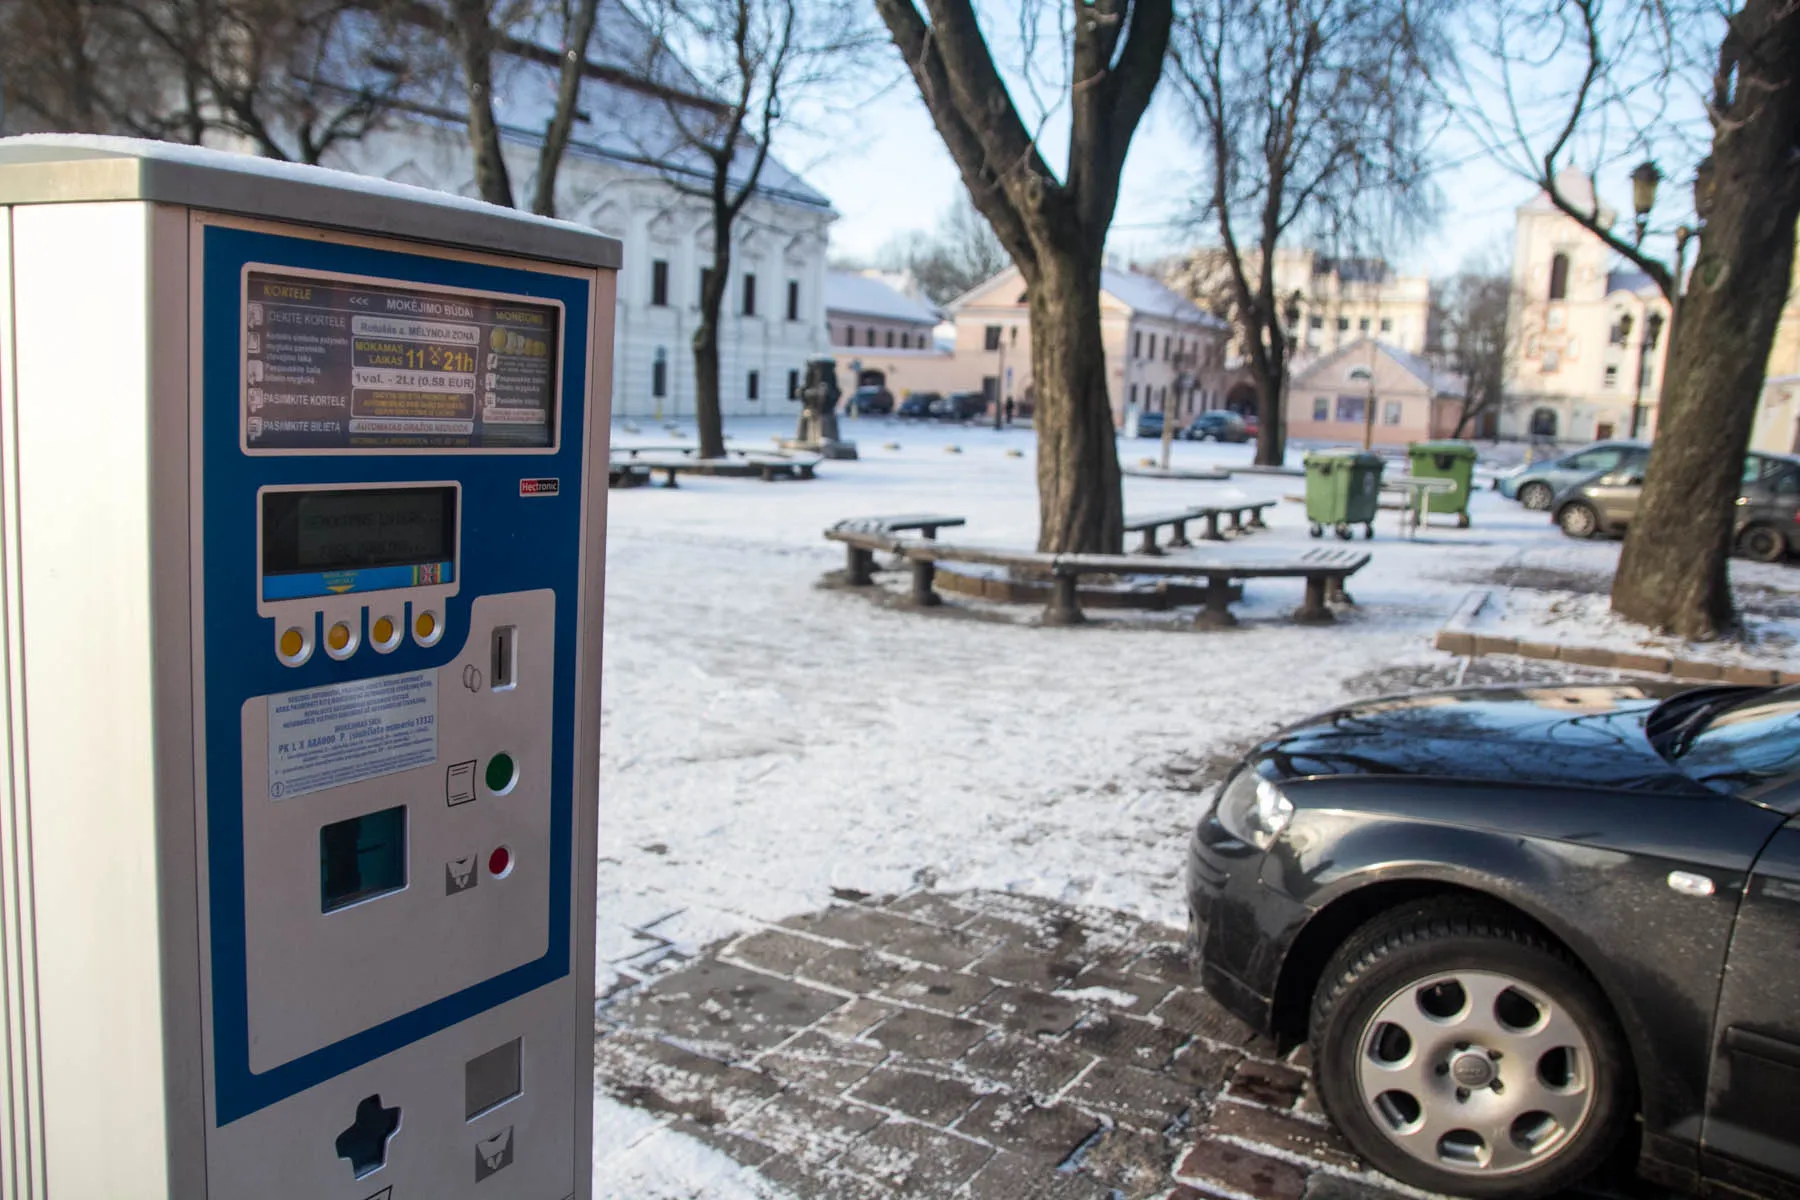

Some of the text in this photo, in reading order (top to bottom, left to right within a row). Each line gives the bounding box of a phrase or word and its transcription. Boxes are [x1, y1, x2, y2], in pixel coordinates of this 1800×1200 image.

[386, 298, 442, 315] MOKĖJIMO
[355, 340, 403, 354] MOKAMAS
[405, 348, 425, 369] 11
[443, 350, 474, 373] 21h
[369, 354, 403, 366] LAIKAS
[395, 374, 415, 386] 2Lt
[448, 377, 475, 390] EUR)
[521, 481, 558, 492] Hectronic
